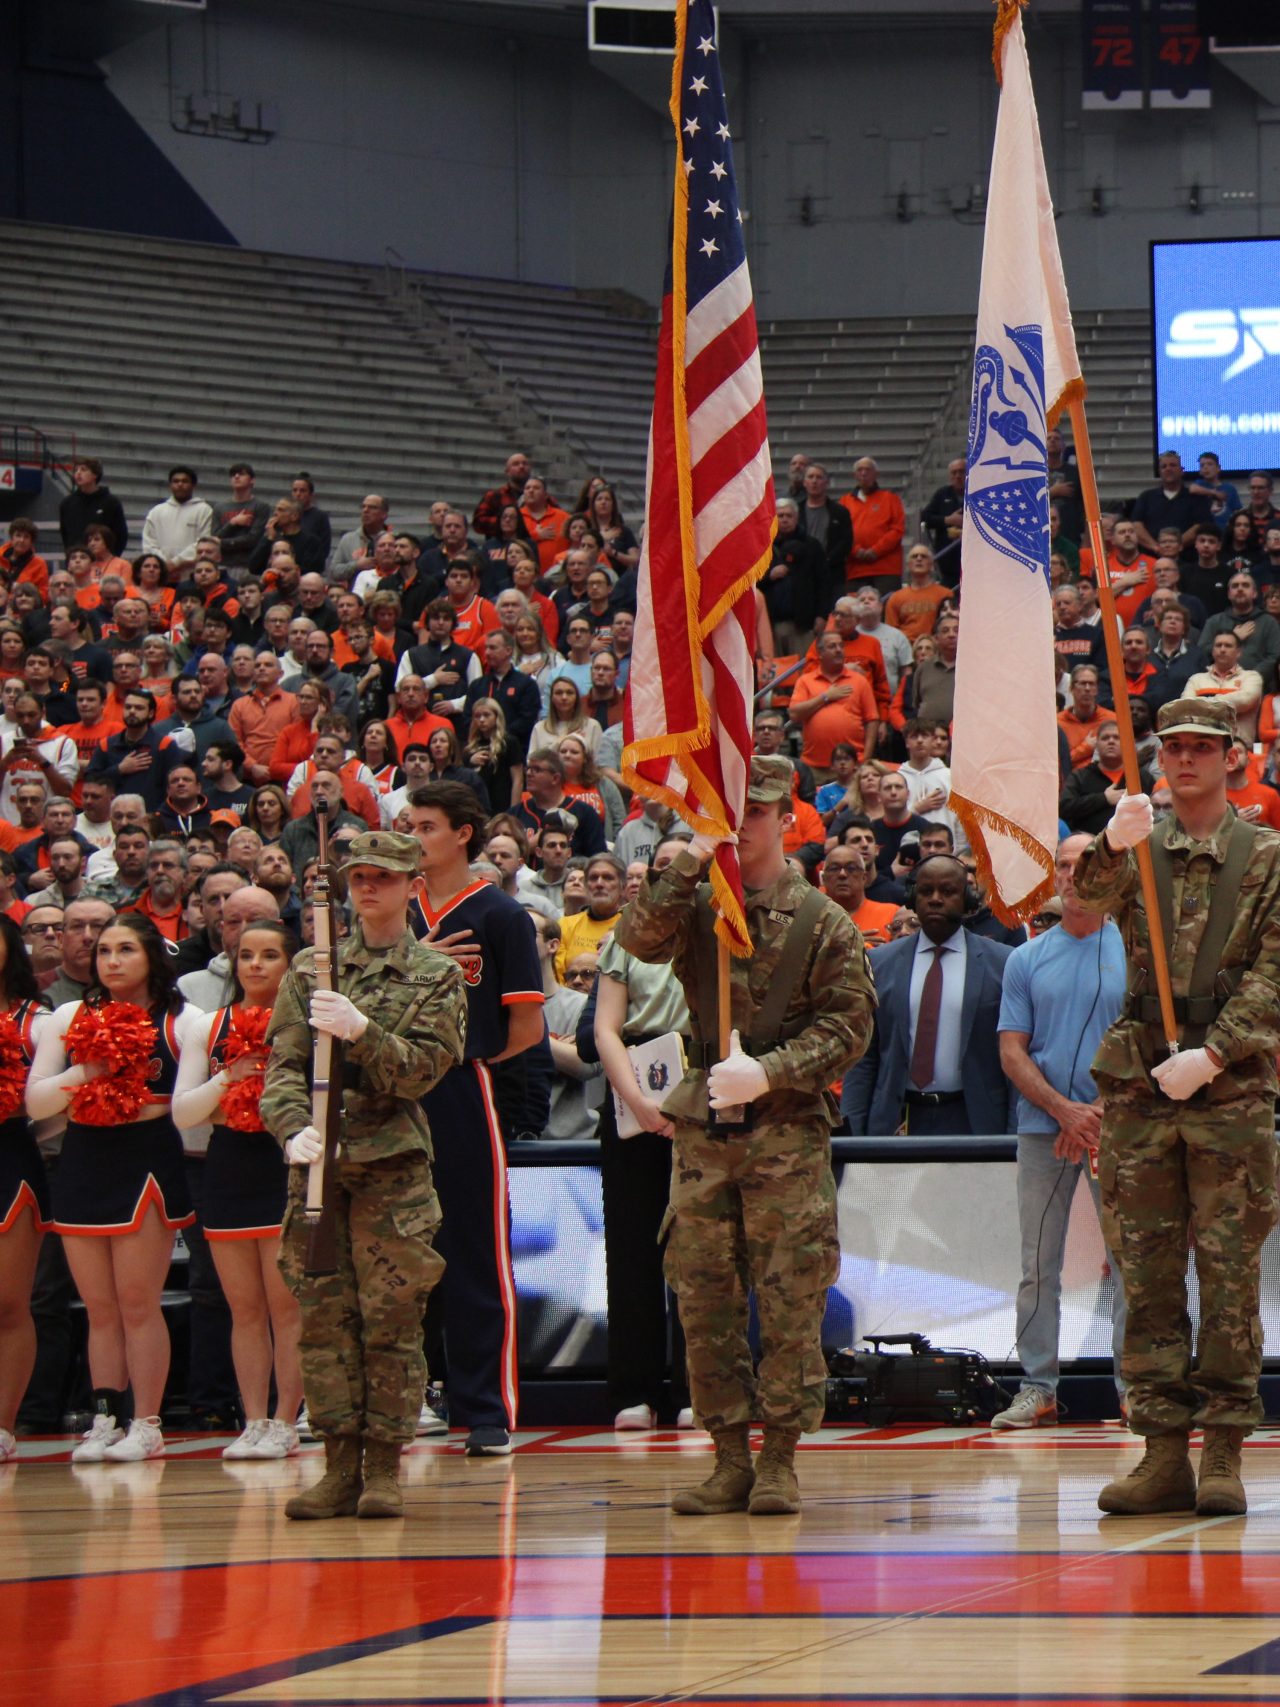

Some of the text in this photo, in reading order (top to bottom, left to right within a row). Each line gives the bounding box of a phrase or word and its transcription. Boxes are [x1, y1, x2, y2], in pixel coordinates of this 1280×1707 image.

[1092, 38, 1134, 67] 72
[1159, 36, 1202, 66] 47
[413, 974, 437, 983] ARMY
